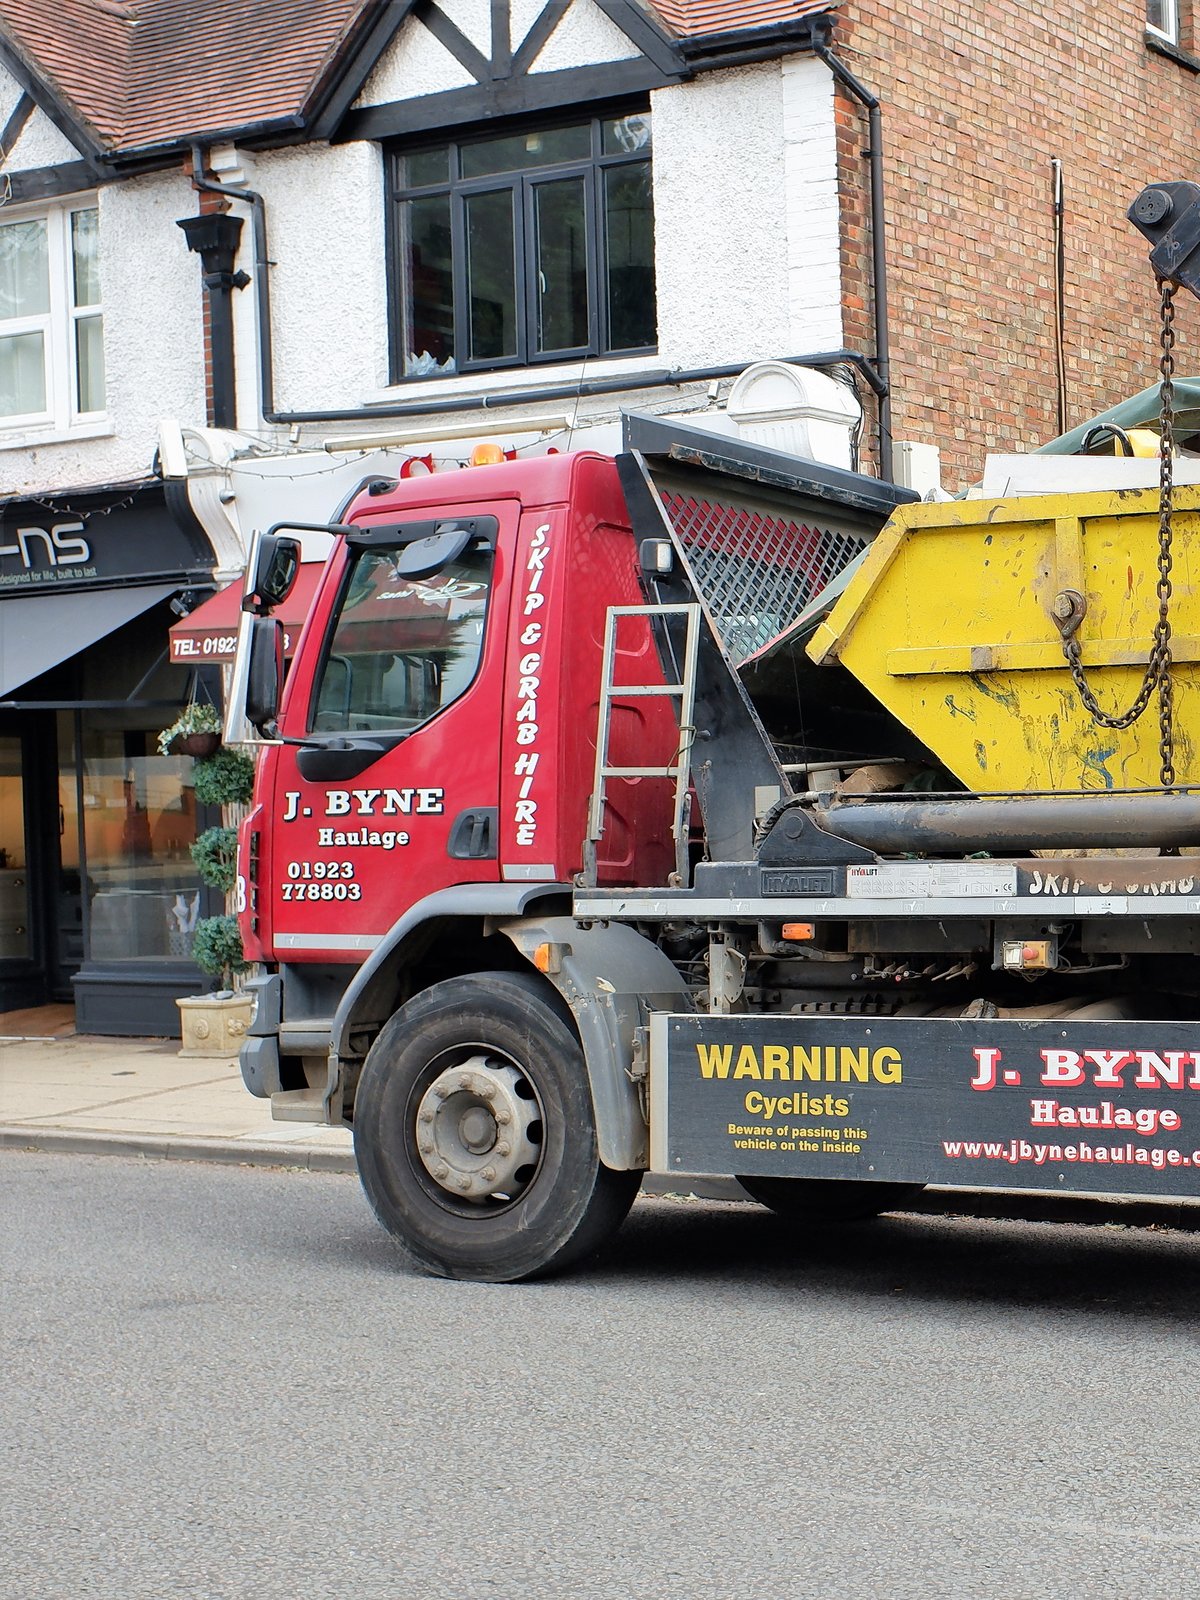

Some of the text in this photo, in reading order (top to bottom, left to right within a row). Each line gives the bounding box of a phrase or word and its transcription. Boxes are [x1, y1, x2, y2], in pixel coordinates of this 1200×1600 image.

[173, 639, 201, 656] TEL:
[514, 524, 551, 846] SKIP & GRAB HIRE
[283, 788, 444, 821] J. BYNE
[318, 828, 409, 850] Haulage
[287, 861, 355, 880] 01923
[281, 883, 361, 901] 778803
[697, 1044, 903, 1084] WARNING
[971, 1048, 1020, 1091] J.
[744, 1090, 850, 1119] Cyclists
[1030, 1099, 1181, 1136] Haulage
[728, 1123, 868, 1140] Beware of passing this
[734, 1138, 861, 1154] vehicle on the inside
